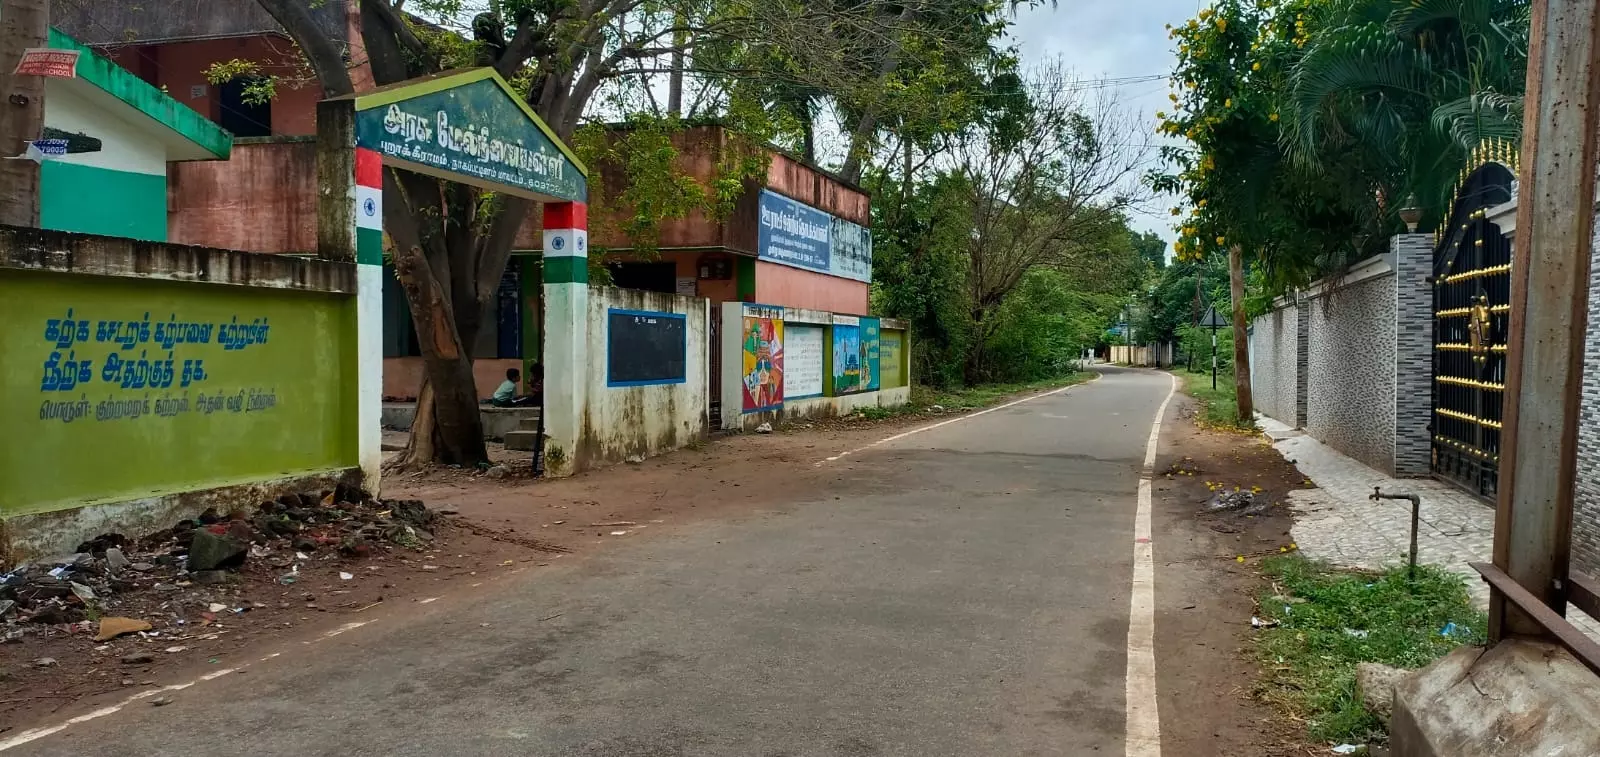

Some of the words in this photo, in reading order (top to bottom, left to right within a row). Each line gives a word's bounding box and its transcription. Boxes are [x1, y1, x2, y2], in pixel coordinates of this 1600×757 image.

[45, 308, 90, 349] கற்க
[96, 312, 150, 350] கசடறக்
[154, 313, 214, 349] கற்பவை
[217, 315, 270, 350] கற்றபின்
[102, 349, 175, 388] அதற்குத்
